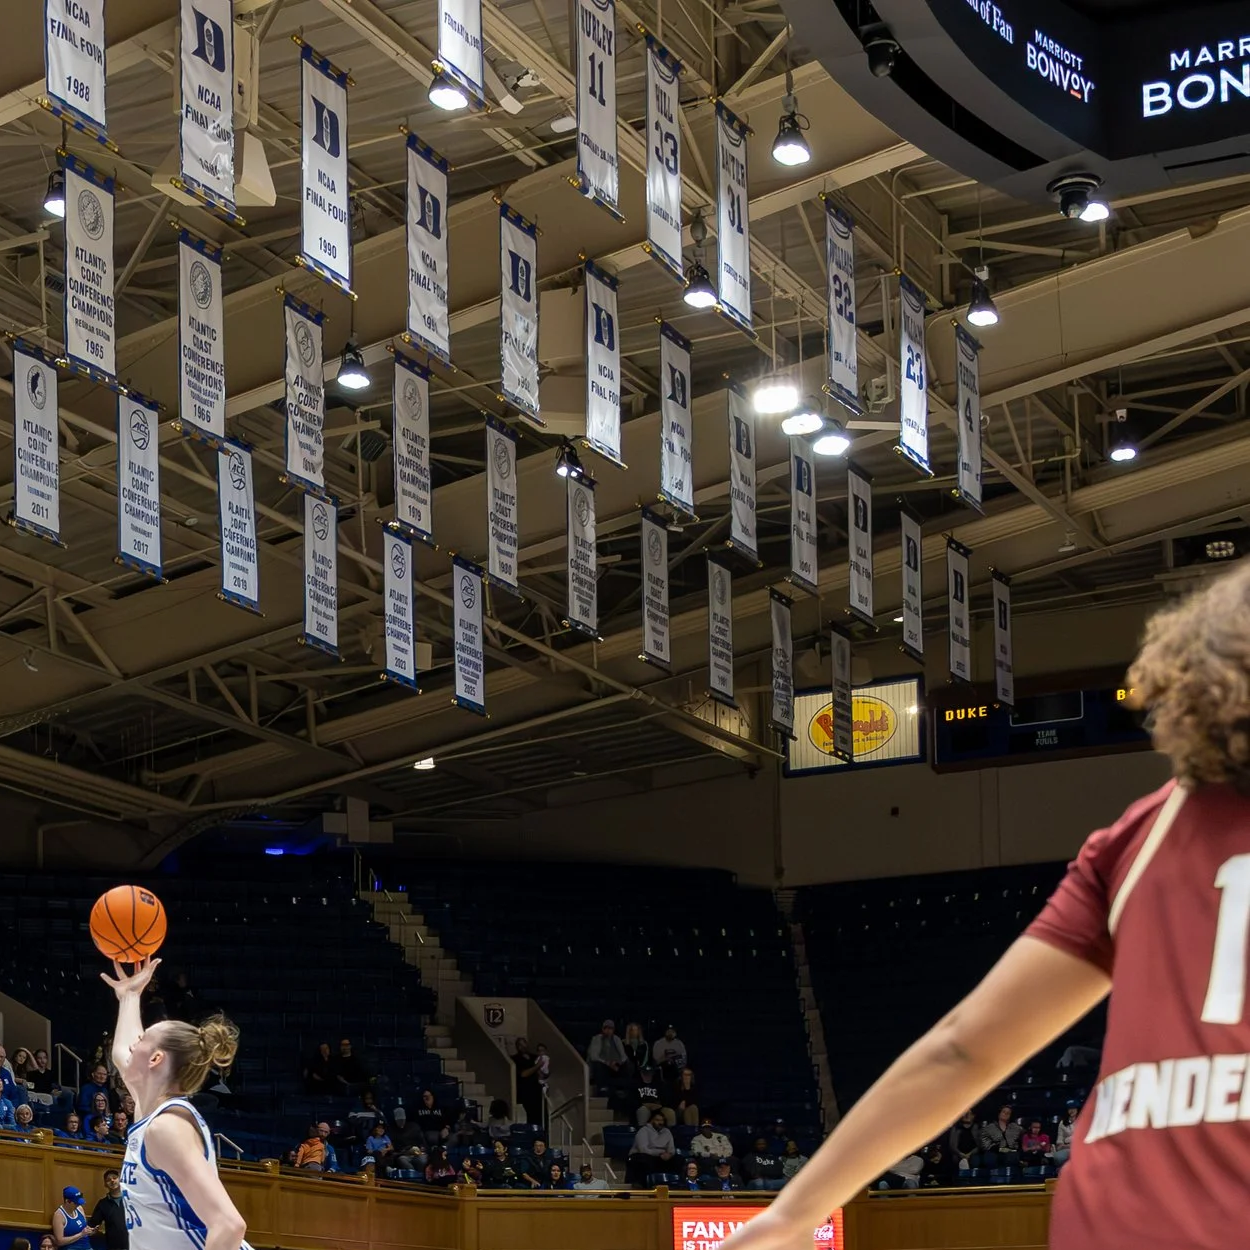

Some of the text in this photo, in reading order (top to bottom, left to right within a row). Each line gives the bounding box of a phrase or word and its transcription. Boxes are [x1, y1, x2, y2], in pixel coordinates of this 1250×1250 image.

[64, 0, 91, 28] NCAA
[992, 5, 1013, 44] Fan
[50, 18, 103, 66] FINAL FOUR
[1035, 29, 1083, 71] MARRIOTT
[588, 52, 606, 107] 11
[1027, 42, 1092, 103] BONVOY
[66, 76, 90, 102] 1988
[198, 84, 221, 112] NCAA
[1143, 63, 1250, 118] BON
[317, 168, 336, 194] NCAA
[306, 186, 327, 213] FINAL
[75, 246, 106, 275] ATLANTIC
[318, 236, 337, 260] 1990
[421, 249, 437, 274] NCAA
[81, 265, 102, 289] COAST
[410, 269, 446, 302] FINAL FOUR
[69, 277, 113, 312] CONFERENCE
[71, 295, 112, 328] CHAMPIONS
[189, 315, 216, 341] ATLANTIC
[86, 339, 104, 360] 1965
[185, 363, 222, 392] CHAMPIONS
[906, 344, 923, 390] 23
[298, 392, 319, 412] COAST
[608, 390, 620, 407] FOU
[194, 404, 211, 423] 1966
[23, 419, 52, 443] ATLANTIC
[133, 421, 149, 435] ACC
[28, 436, 47, 456] COAST
[18, 447, 59, 475] CONFERENCE
[128, 460, 154, 482] ATLANTIC
[20, 463, 58, 491] CHAMPIONS
[132, 476, 149, 495] COAST
[32, 502, 49, 520] 2011
[122, 487, 160, 514] CONFERENCE
[125, 502, 159, 528] CHAMPIONS
[133, 539, 149, 555] 2017
[233, 575, 247, 591] 2019
[945, 706, 987, 721] DUKE
[1035, 736, 1058, 746] FOULS
[1037, 729, 1057, 738] TEAM
[682, 1221, 724, 1239] FAN
[683, 1241, 695, 1250] IS
